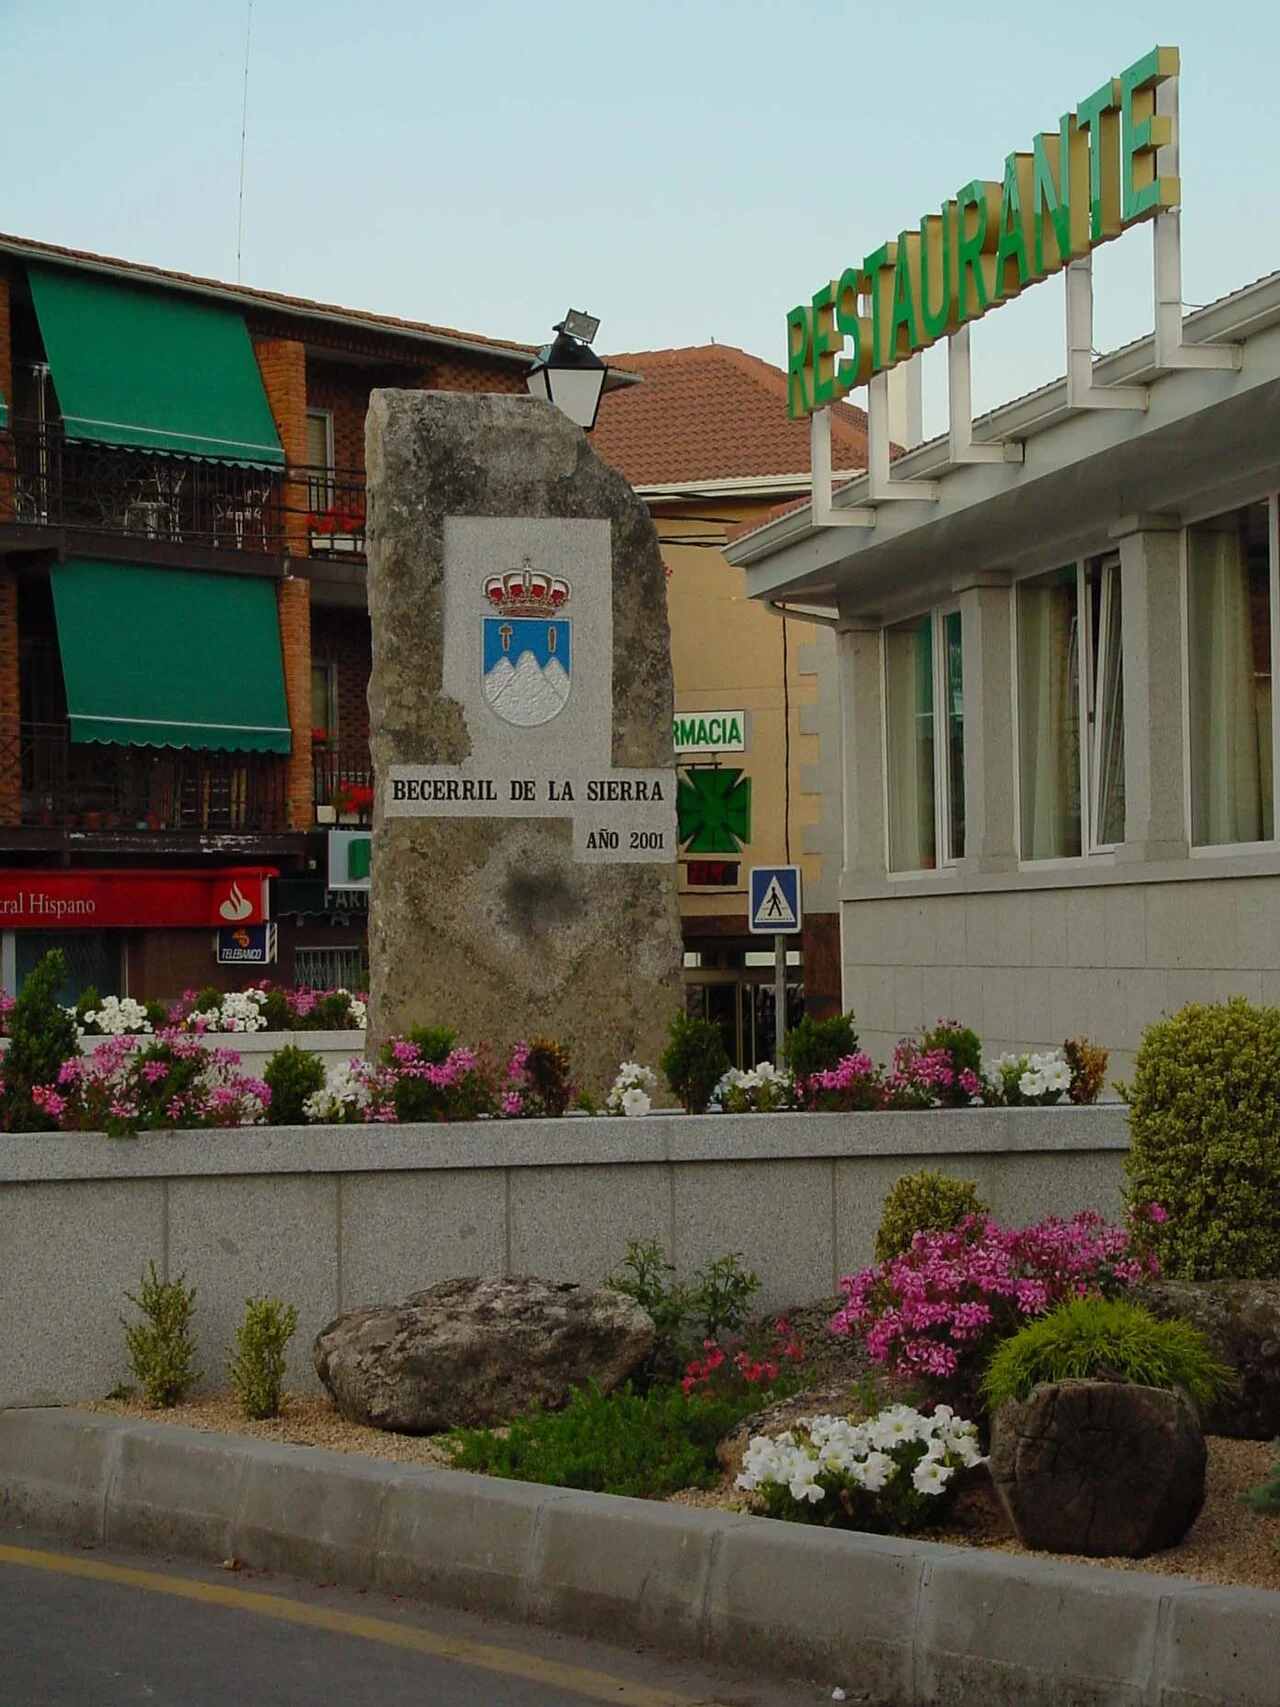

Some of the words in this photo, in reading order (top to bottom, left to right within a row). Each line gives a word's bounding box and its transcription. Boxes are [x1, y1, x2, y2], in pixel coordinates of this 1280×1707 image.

[786, 46, 1180, 420] RESTAURANTE
[392, 780, 498, 802] BECERRIL
[510, 780, 536, 802] DE
[548, 780, 575, 802] LA
[587, 780, 664, 802] SIERRA
[586, 827, 619, 850] AÑO
[629, 831, 665, 850] 2001
[29, 893, 96, 919] Hispano
